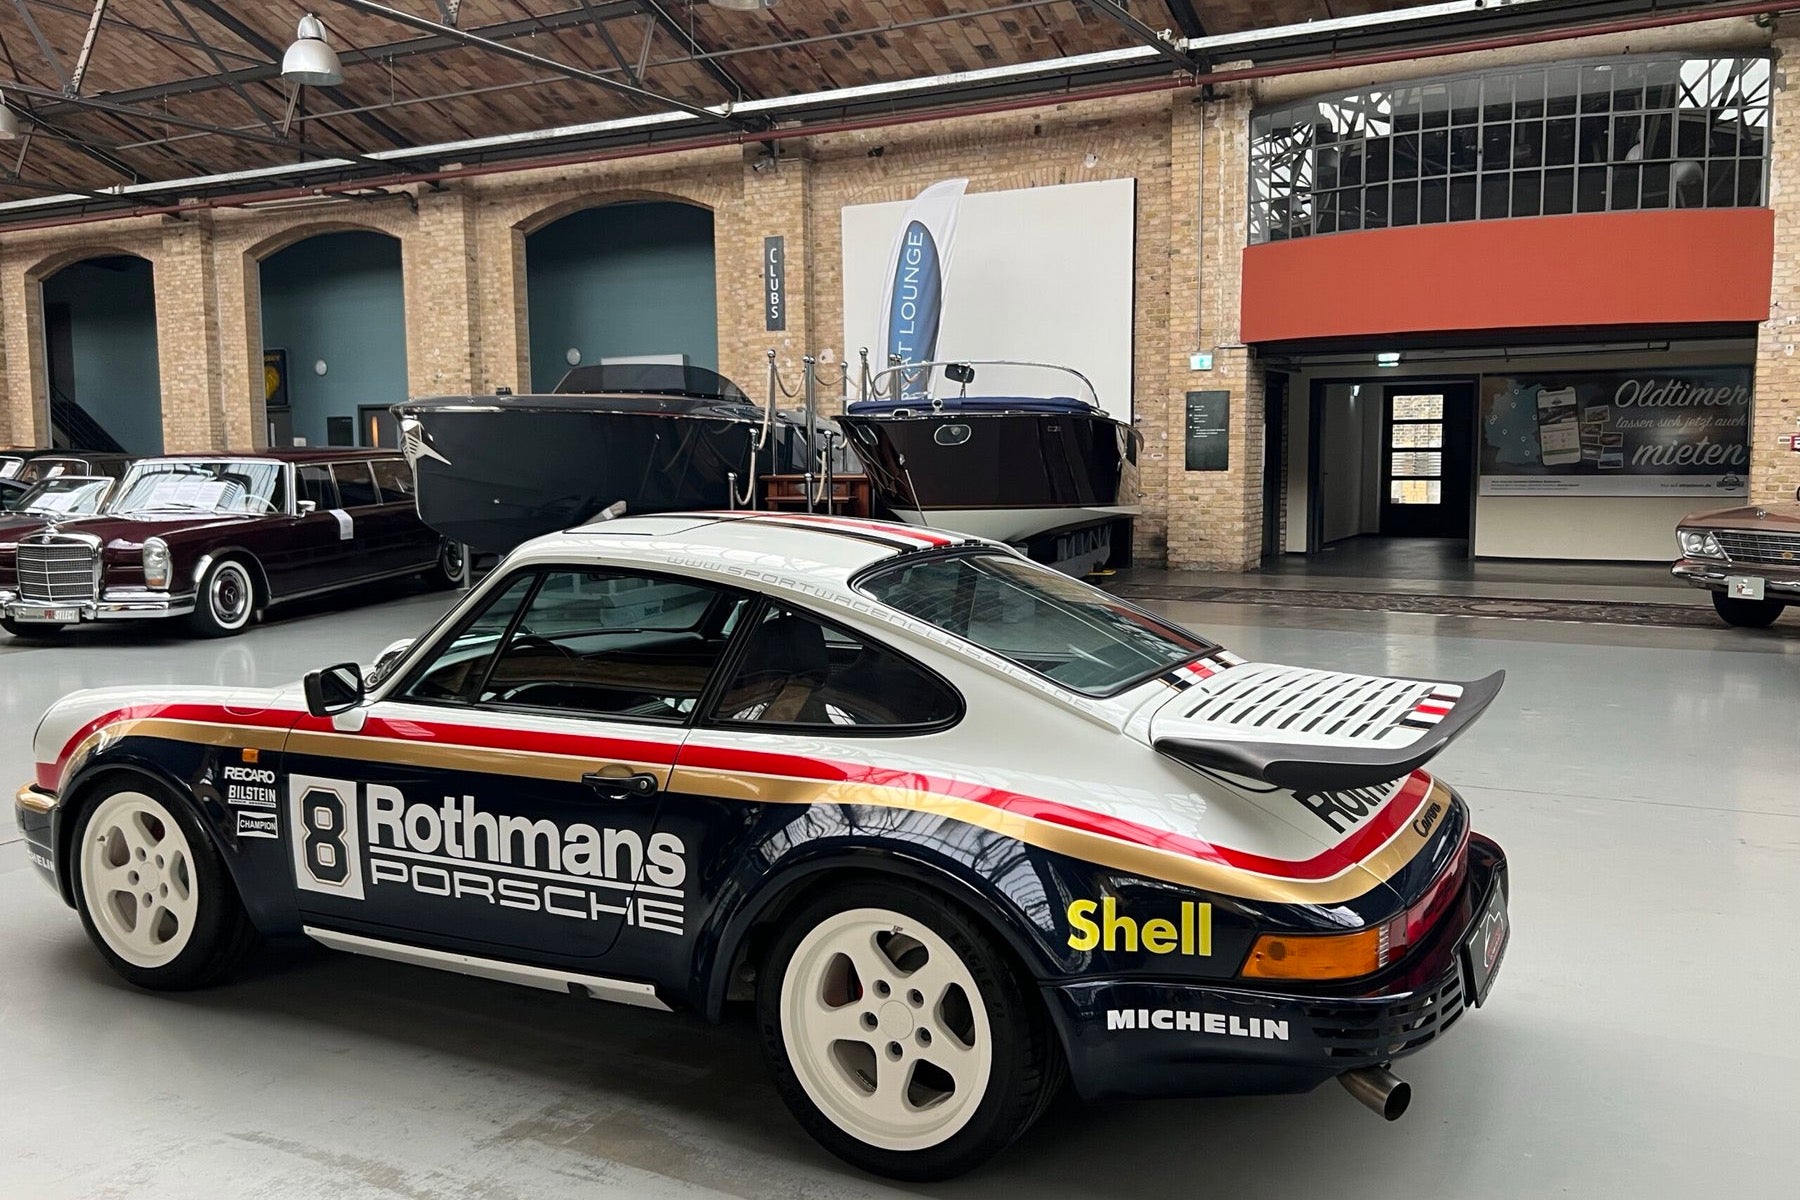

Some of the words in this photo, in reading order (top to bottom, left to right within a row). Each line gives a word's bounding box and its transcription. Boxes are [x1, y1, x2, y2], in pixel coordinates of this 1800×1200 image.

[770, 247, 780, 320] CLUBS
[900, 231, 924, 335] LOUNGE
[1614, 379, 1749, 408] Oldtimer
[1616, 416, 1653, 428] lassen
[1657, 415, 1683, 427] sich
[1680, 417, 1713, 433] jetzt
[1714, 414, 1747, 427] auch
[1632, 436, 1747, 466] mieten
[224, 766, 276, 784] RECARO
[228, 784, 277, 802] BILSTEIN
[240, 819, 276, 831] CHAMPION
[300, 785, 350, 886] 8
[366, 783, 687, 888] Rothmans
[371, 857, 684, 936] PORSCHE
[1067, 897, 1212, 956] Shell
[1107, 1009, 1289, 1041] MICHELIN
